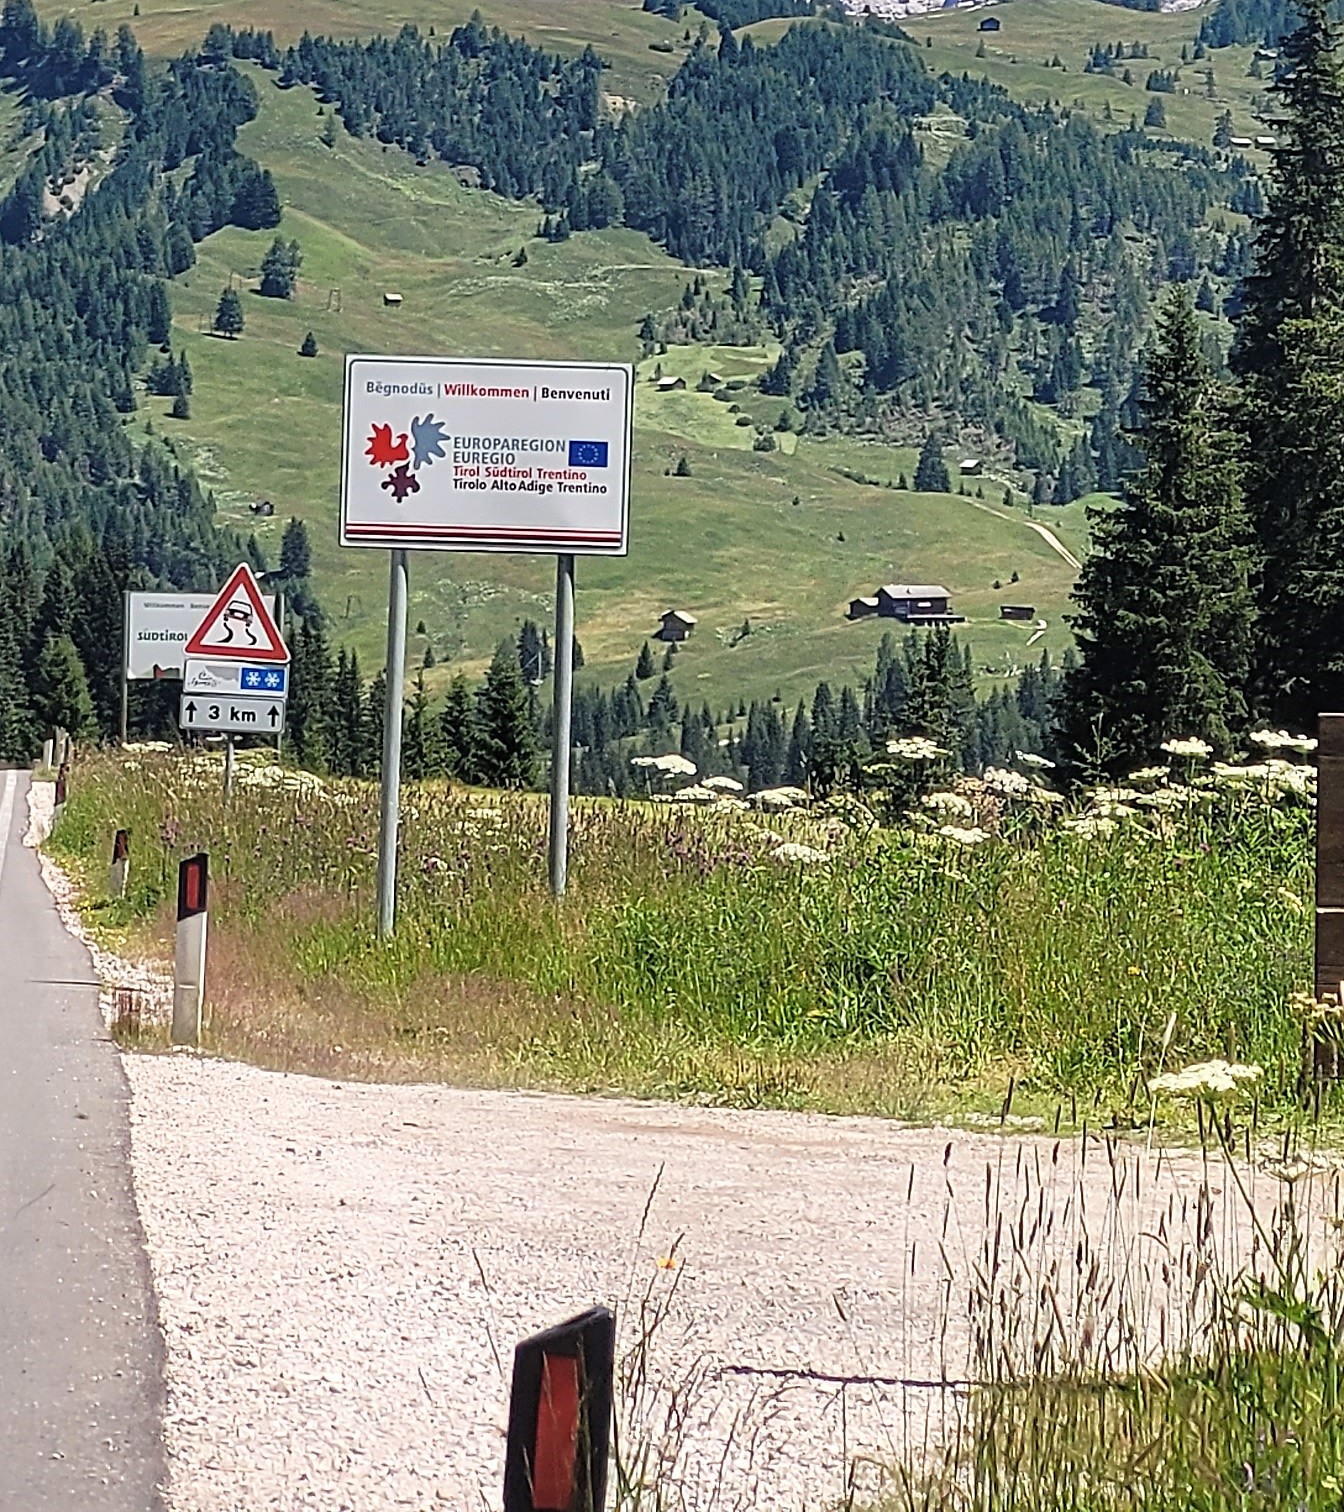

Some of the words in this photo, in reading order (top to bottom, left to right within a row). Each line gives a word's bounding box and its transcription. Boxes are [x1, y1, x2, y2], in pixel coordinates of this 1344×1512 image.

[365, 380, 434, 396] Bëgnodüs
[444, 382, 530, 399] Willkommen
[541, 386, 611, 401] Benvenuti
[452, 436, 566, 453] EUROPAREGION
[452, 451, 516, 466] EUREGIO
[452, 466, 480, 478] Tirol
[484, 466, 533, 479] Südtirol
[537, 468, 587, 481] Trentino
[452, 478, 488, 491] Tirolo
[557, 481, 608, 495] Trentino
[208, 705, 220, 720] 3
[230, 706, 256, 722] km
